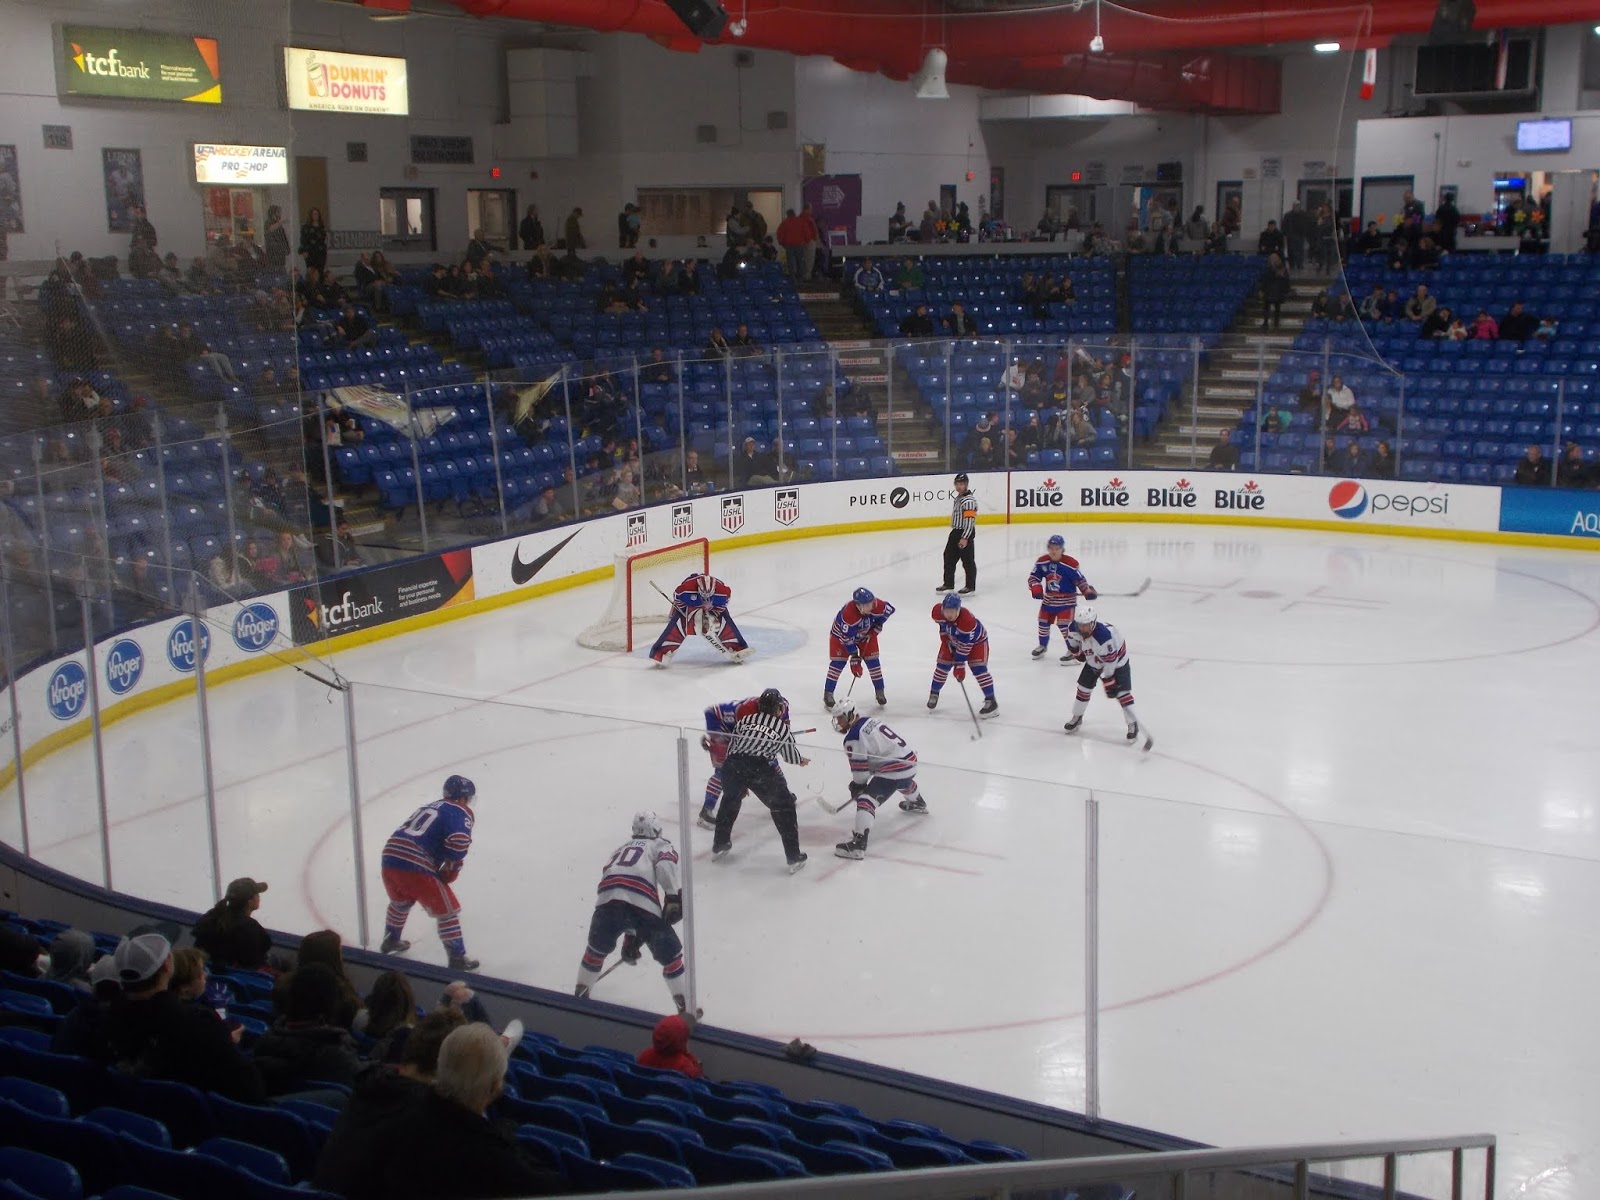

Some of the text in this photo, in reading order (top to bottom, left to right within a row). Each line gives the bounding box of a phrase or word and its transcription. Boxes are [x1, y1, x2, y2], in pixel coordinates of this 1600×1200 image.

[329, 64, 388, 83] DUNKIN'
[331, 82, 386, 101] DONUTS
[221, 161, 240, 171] PRO
[776, 500, 797, 510] USHL
[850, 489, 976, 507] PURE HOCK
[1015, 489, 1063, 508] Blue
[1080, 488, 1130, 507] Blue
[1147, 488, 1197, 508] Blue
[1215, 490, 1265, 510] Blue
[1371, 493, 1449, 517] pepsi
[673, 516, 691, 526] USHL
[722, 508, 742, 517] USHL
[629, 526, 645, 536] USHL
[397, 580, 438, 593] Financial expertise
[405, 592, 416, 600] your
[416, 587, 435, 597] personal
[408, 596, 428, 606] business
[427, 592, 441, 600] needs
[237, 612, 276, 645] Kroger
[108, 651, 141, 687] Kroger
[51, 673, 85, 711] Kroger
[879, 724, 907, 748] 9
